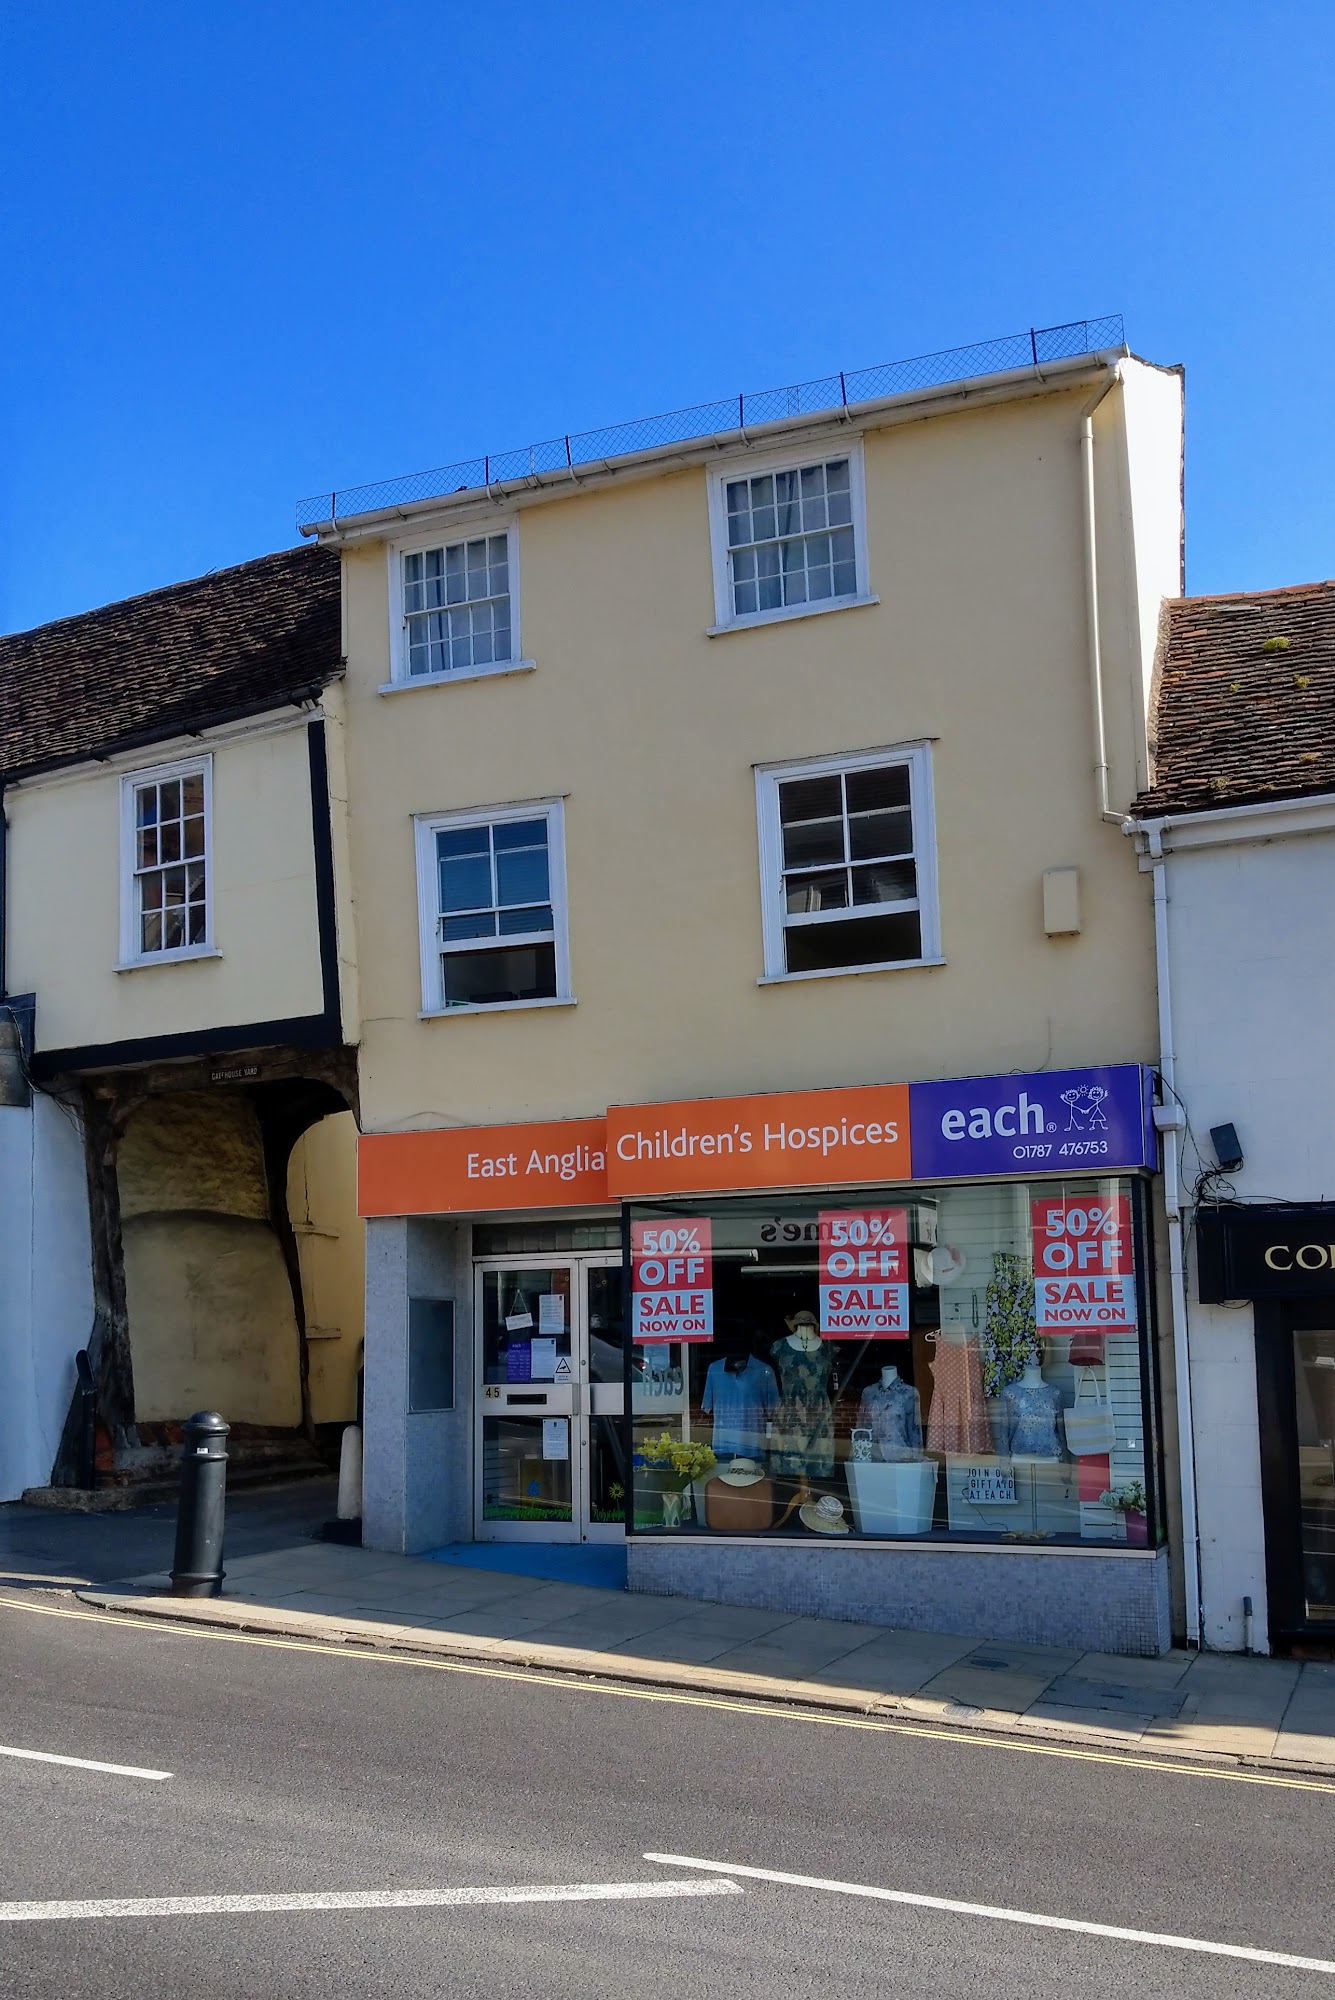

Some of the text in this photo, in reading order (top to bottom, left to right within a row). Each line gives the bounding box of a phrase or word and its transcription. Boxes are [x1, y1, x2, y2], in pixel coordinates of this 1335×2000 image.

[244, 1067, 258, 1076] YARD
[616, 1117, 899, 1161] Children's Hospices
[1013, 1140, 1108, 1159] 01787 476753
[467, 1153, 518, 1178] East
[830, 1218, 895, 1247] 50%
[1045, 1206, 1118, 1238] 50%
[642, 1227, 701, 1256] 50%
[827, 1249, 899, 1278] OFF
[1042, 1239, 1123, 1270] OFF
[639, 1257, 704, 1286] OFF
[828, 1289, 899, 1311] SALE
[1044, 1281, 1124, 1305] SALE
[640, 1294, 705, 1317] SALE
[1044, 1307, 1126, 1322] NOW ON
[640, 1318, 706, 1332] NOW ON
[827, 1314, 901, 1327] NOW ON
[485, 1387, 500, 1398] 45
[967, 1468, 1013, 1478] JOIN OR
[971, 1479, 991, 1488] GIFT
[970, 1490, 980, 1499] AT
